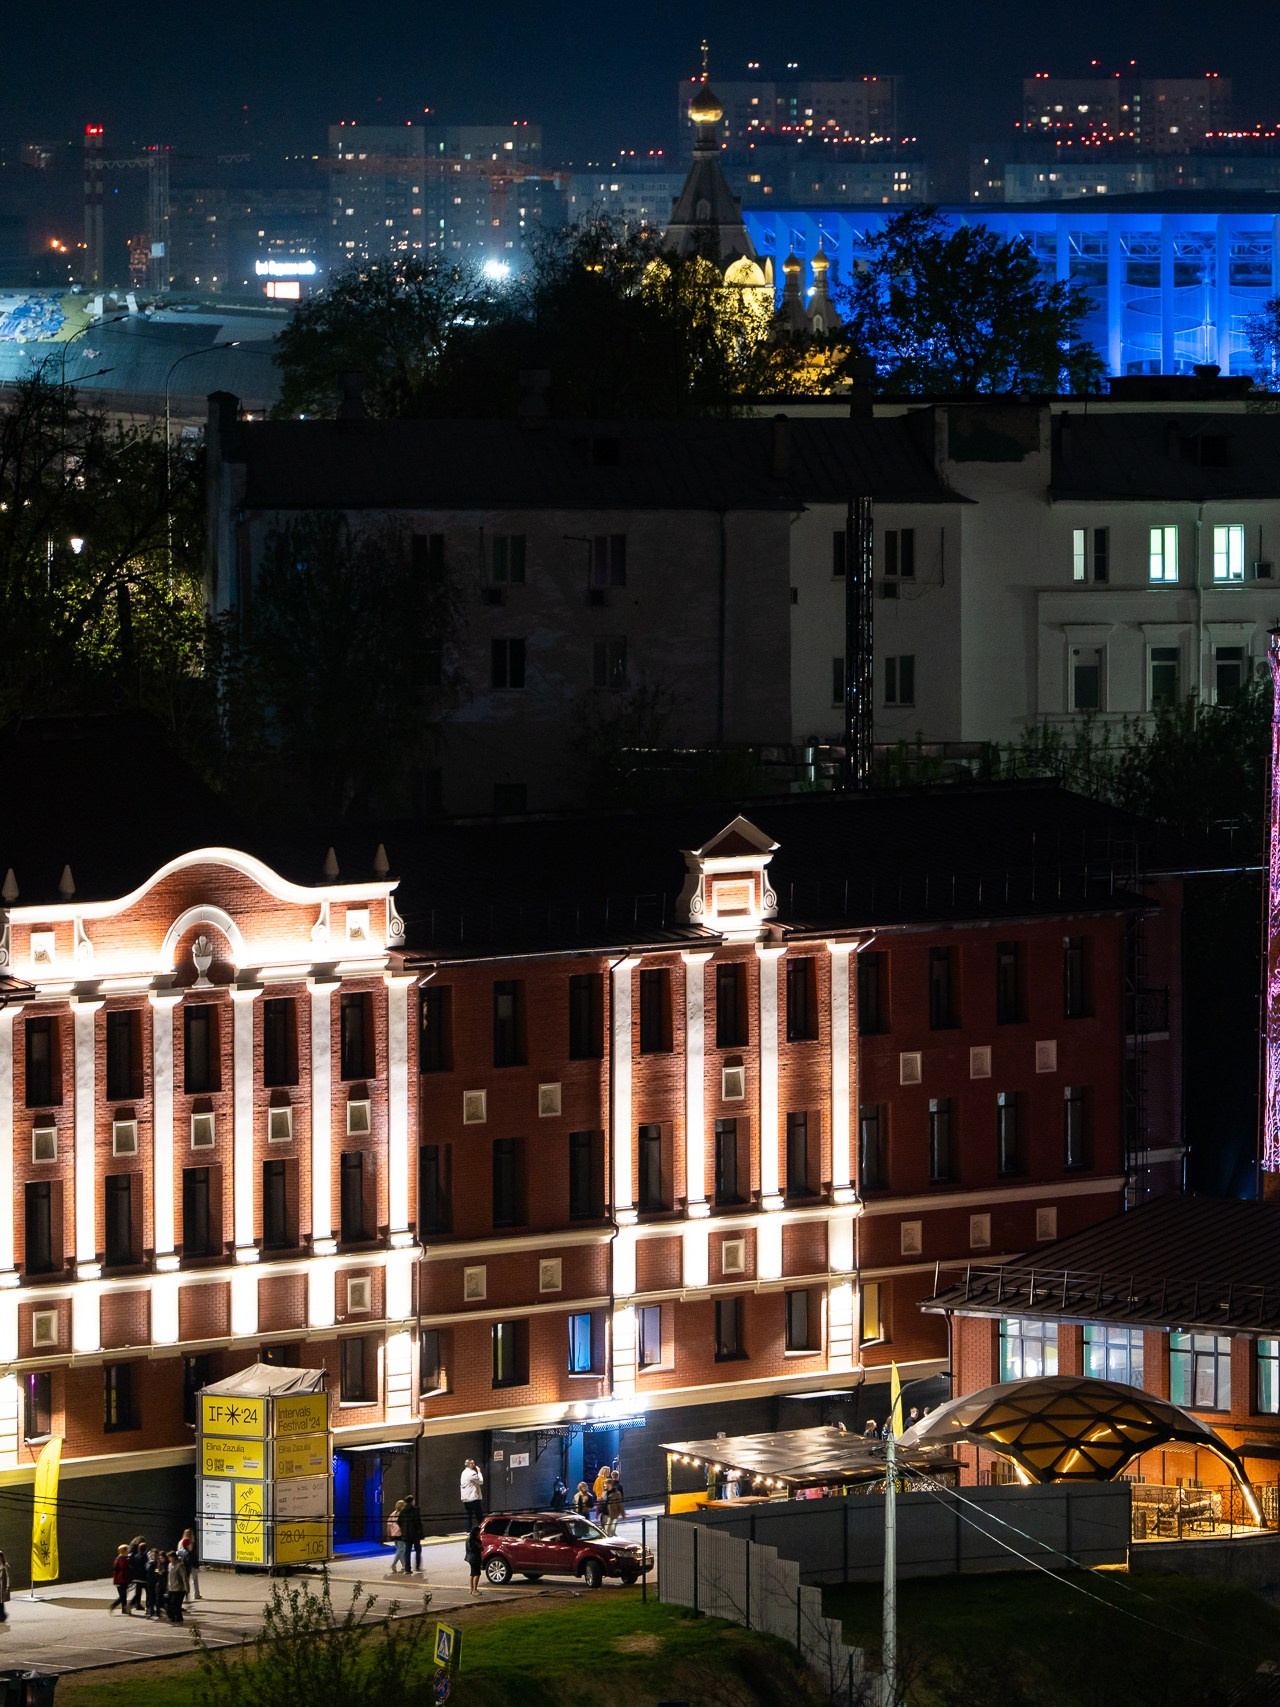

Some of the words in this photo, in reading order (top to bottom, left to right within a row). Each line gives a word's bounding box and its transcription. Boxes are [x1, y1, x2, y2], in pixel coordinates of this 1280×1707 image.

[278, 1406, 311, 1419] Intervals
[278, 1418, 308, 1432] Festival
[206, 1458, 214, 1472] 9
[240, 1487, 254, 1501] The
[242, 1535, 260, 1545] Now
[280, 1529, 306, 1545] 28.04
